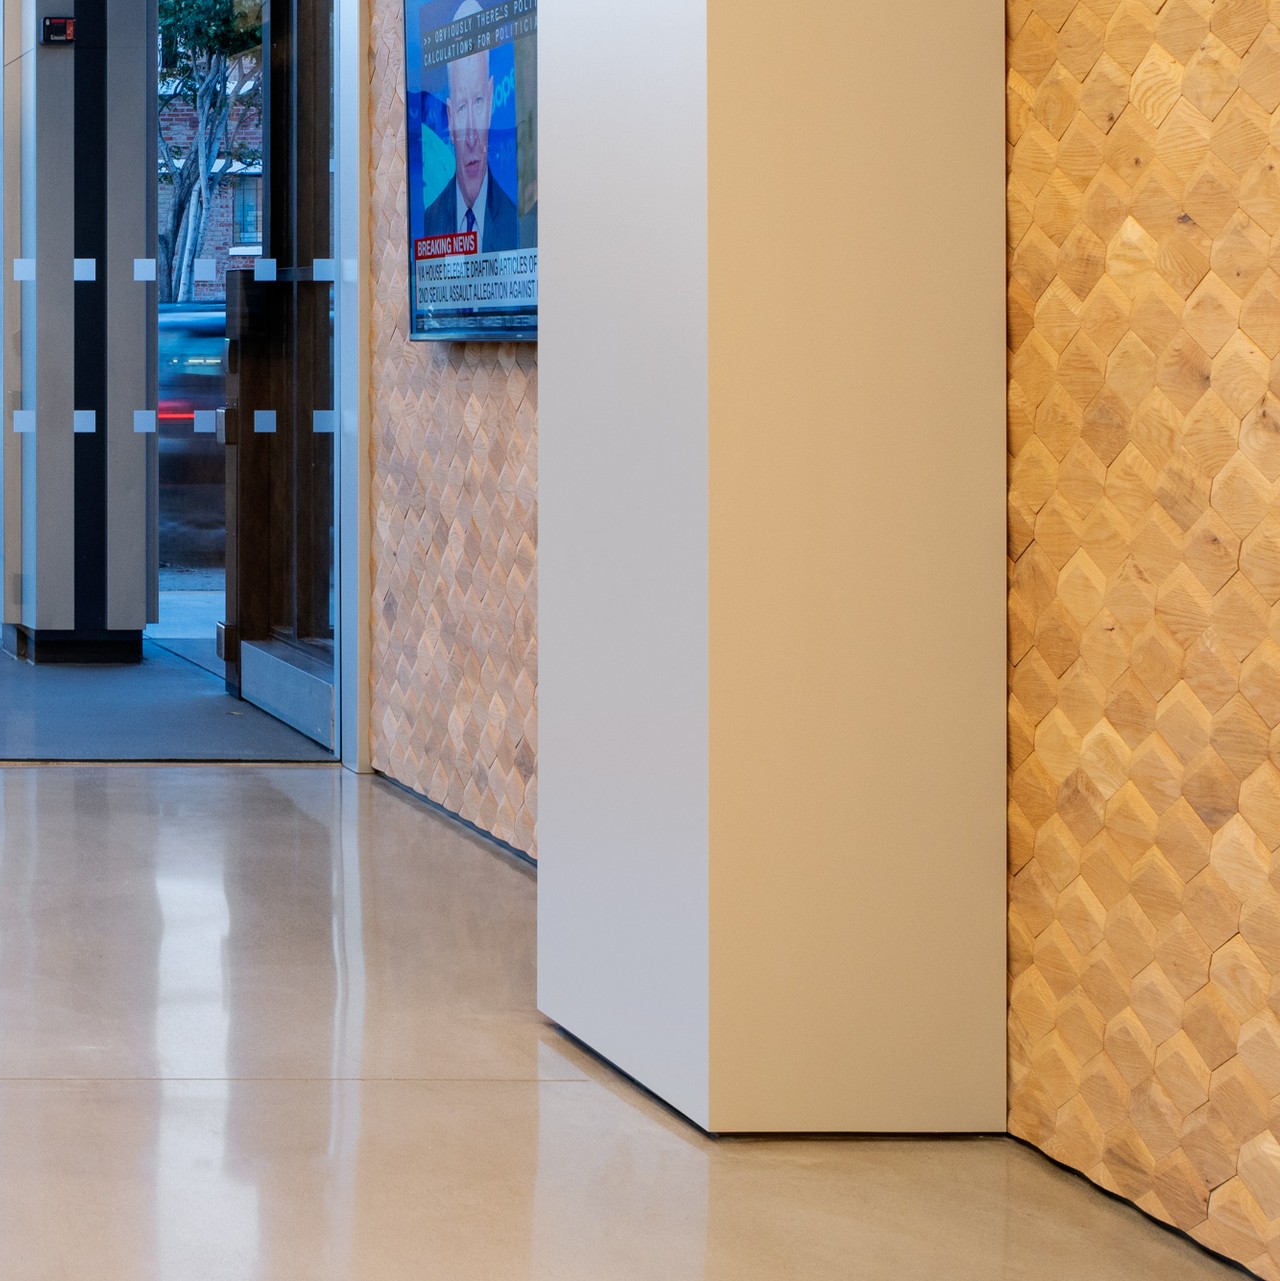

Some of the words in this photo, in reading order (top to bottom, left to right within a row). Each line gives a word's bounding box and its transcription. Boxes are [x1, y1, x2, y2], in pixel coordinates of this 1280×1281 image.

[434, 19, 472, 43] OBVIOUSLY
[476, 4, 508, 28] THERE'S
[424, 39, 472, 66] CALCULATIONS
[477, 32, 490, 48] FOR
[418, 238, 452, 257] BREAKING
[453, 235, 475, 253] NEWS
[426, 264, 442, 281] HOUSE
[444, 262, 470, 280] DELEGATE
[471, 259, 498, 278] DRAFTING
[500, 256, 527, 276] ARTICLES
[529, 255, 537, 273] OF
[429, 286, 448, 303] SEXUAL
[450, 284, 472, 302] ASSAULT
[474, 282, 508, 300] ALLEGATION
[510, 280, 536, 298] AGAINST
